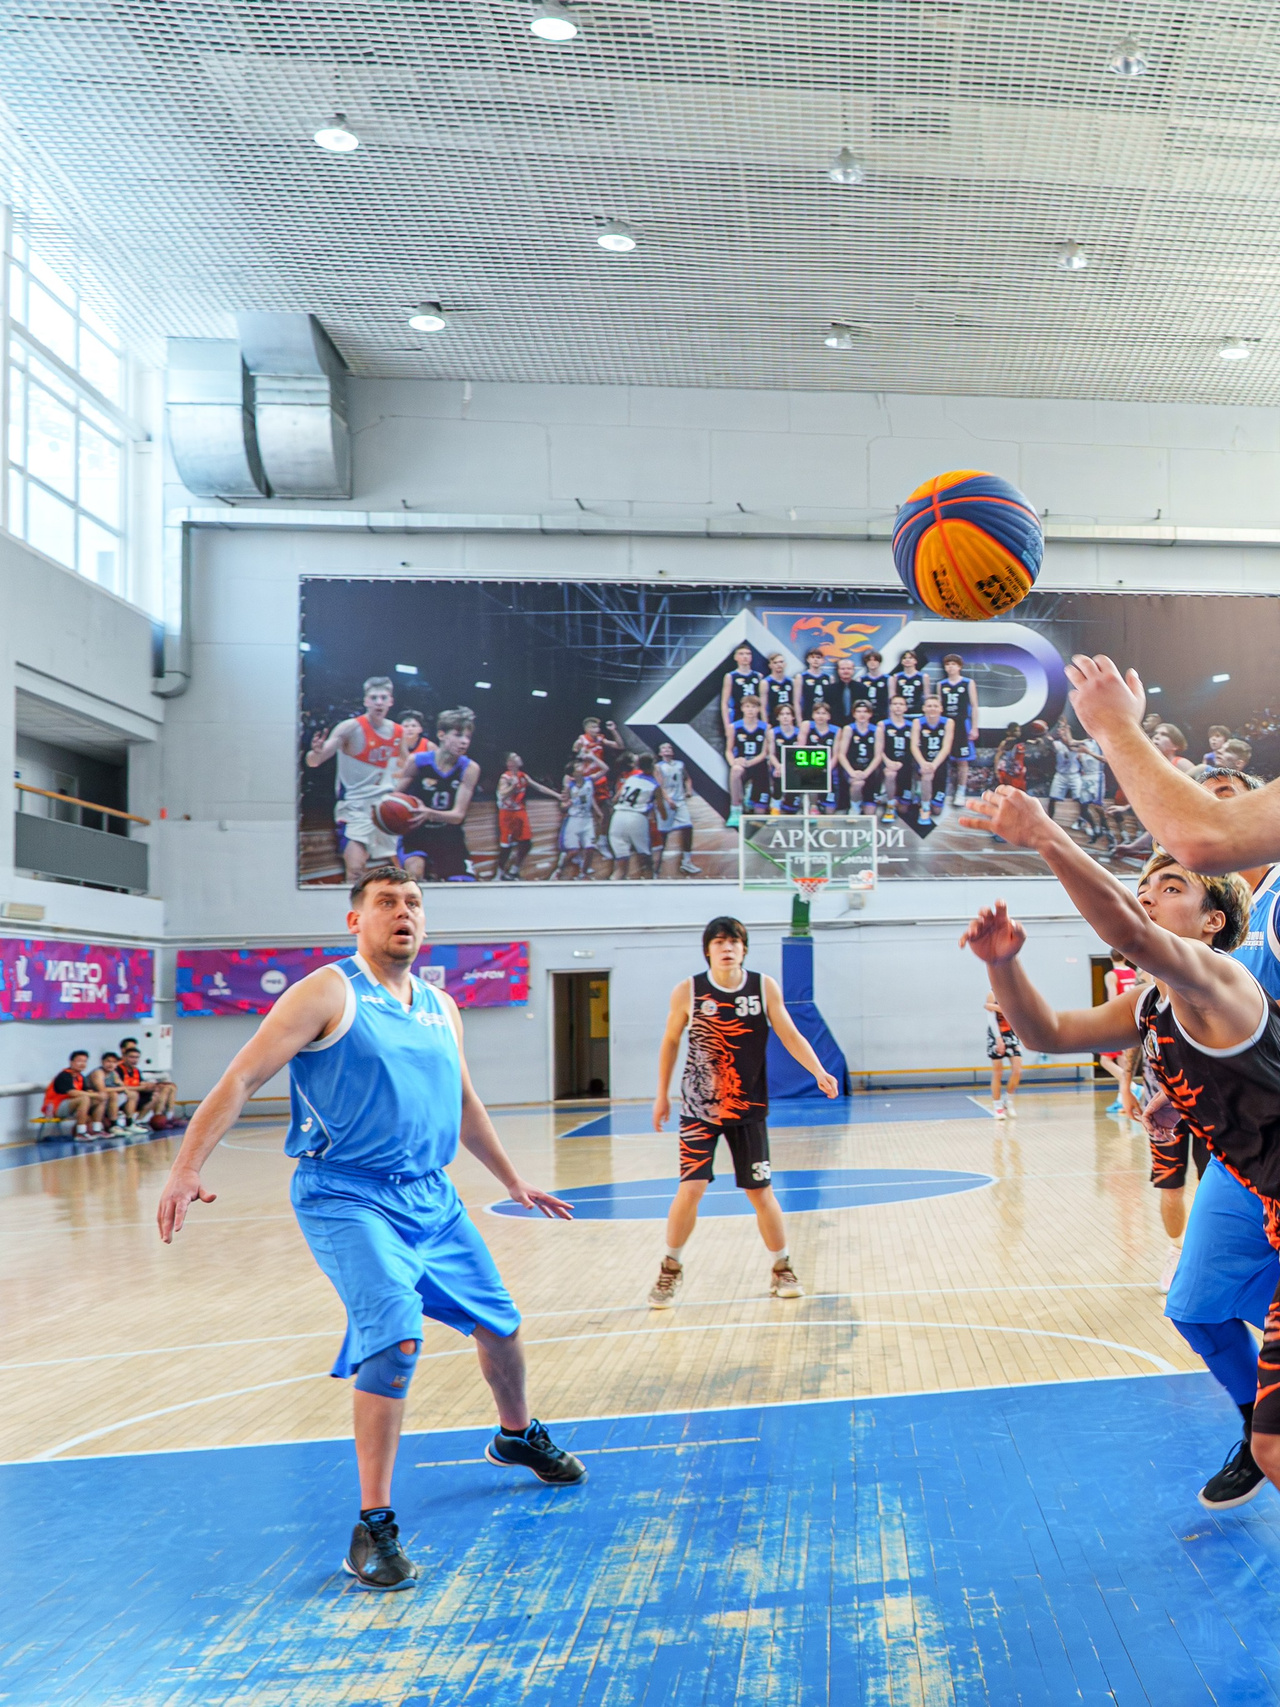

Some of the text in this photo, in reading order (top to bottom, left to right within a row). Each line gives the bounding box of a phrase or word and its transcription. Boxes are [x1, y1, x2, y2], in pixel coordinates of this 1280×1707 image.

[767, 825, 907, 849] АРХСТРОЙ
[734, 995, 762, 1018] 35
[752, 1160, 772, 1182] 35
